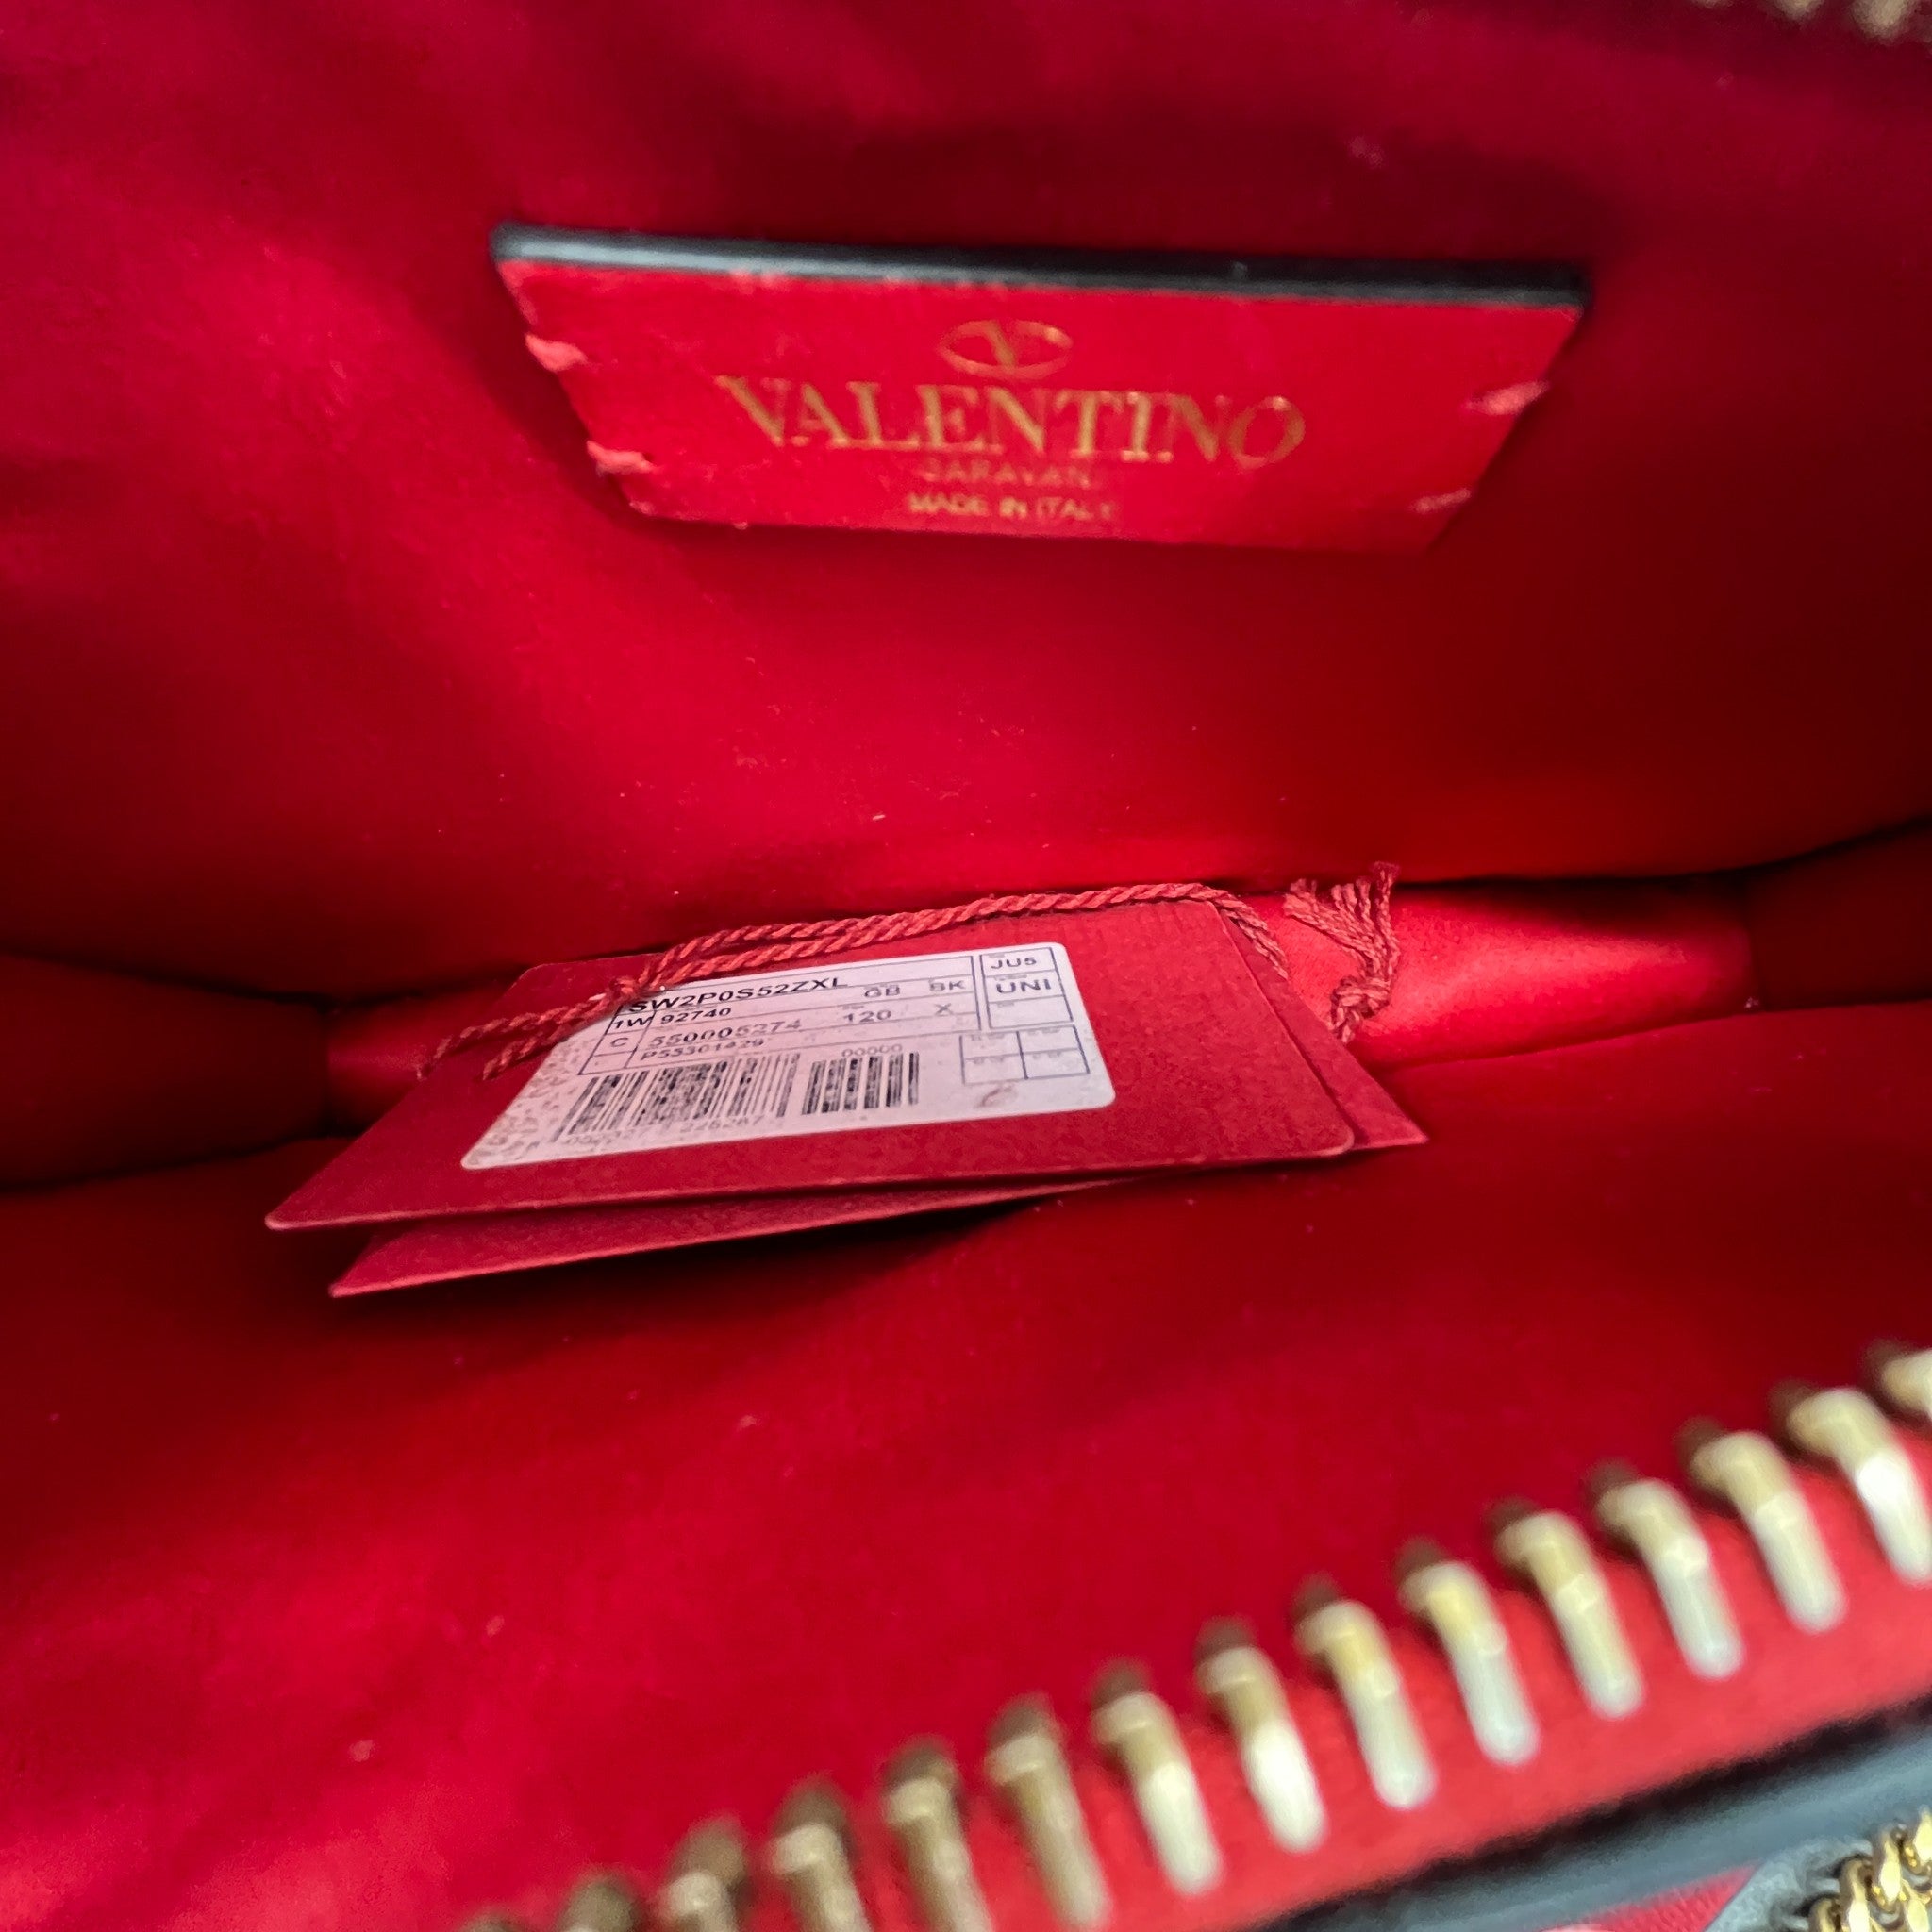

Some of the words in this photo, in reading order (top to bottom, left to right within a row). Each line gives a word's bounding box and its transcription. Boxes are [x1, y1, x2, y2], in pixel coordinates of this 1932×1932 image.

[714, 375, 1306, 470] VALENTINO
[991, 957, 1038, 970] JU5
[995, 978, 1052, 995] UNI
[661, 1007, 732, 1024] 92740
[842, 1009, 892, 1024] 120
